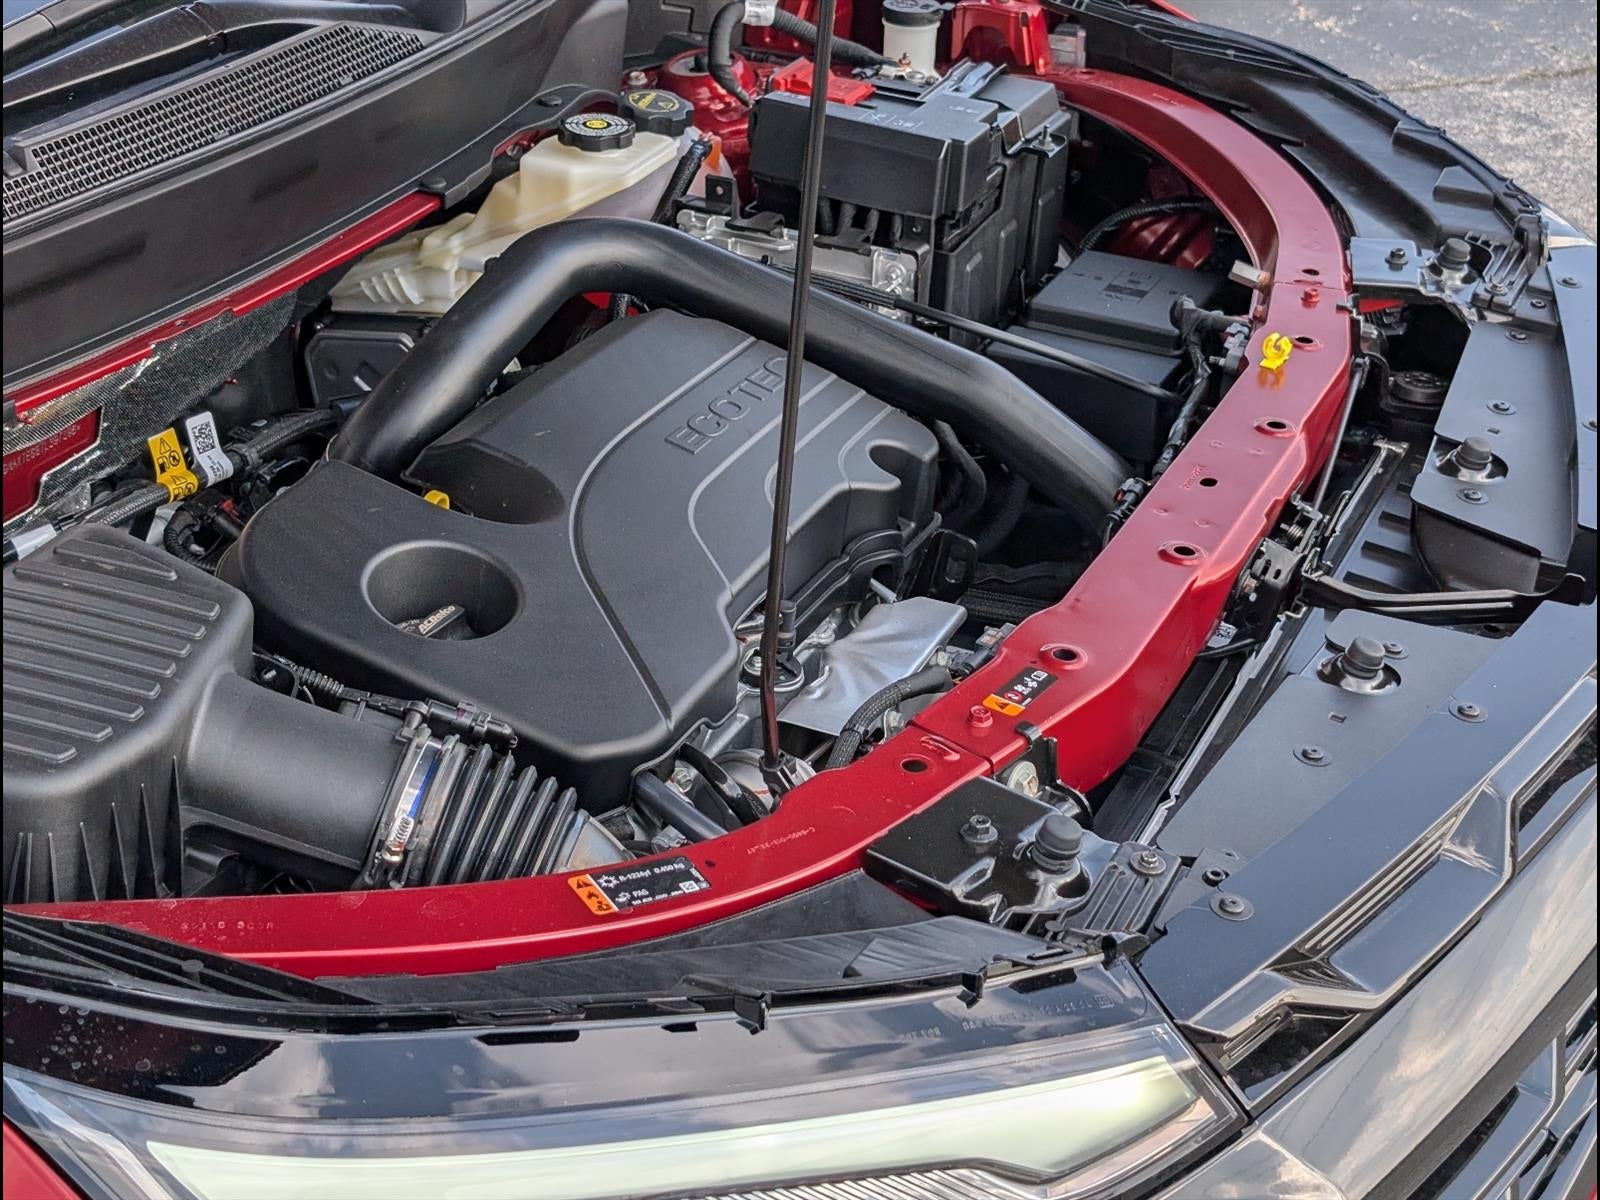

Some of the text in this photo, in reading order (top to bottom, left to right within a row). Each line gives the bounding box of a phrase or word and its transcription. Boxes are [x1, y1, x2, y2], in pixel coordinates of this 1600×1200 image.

[418, 605, 455, 634] ACDelco
[618, 869, 651, 882] R-1234yf
[632, 888, 649, 898] PAG
